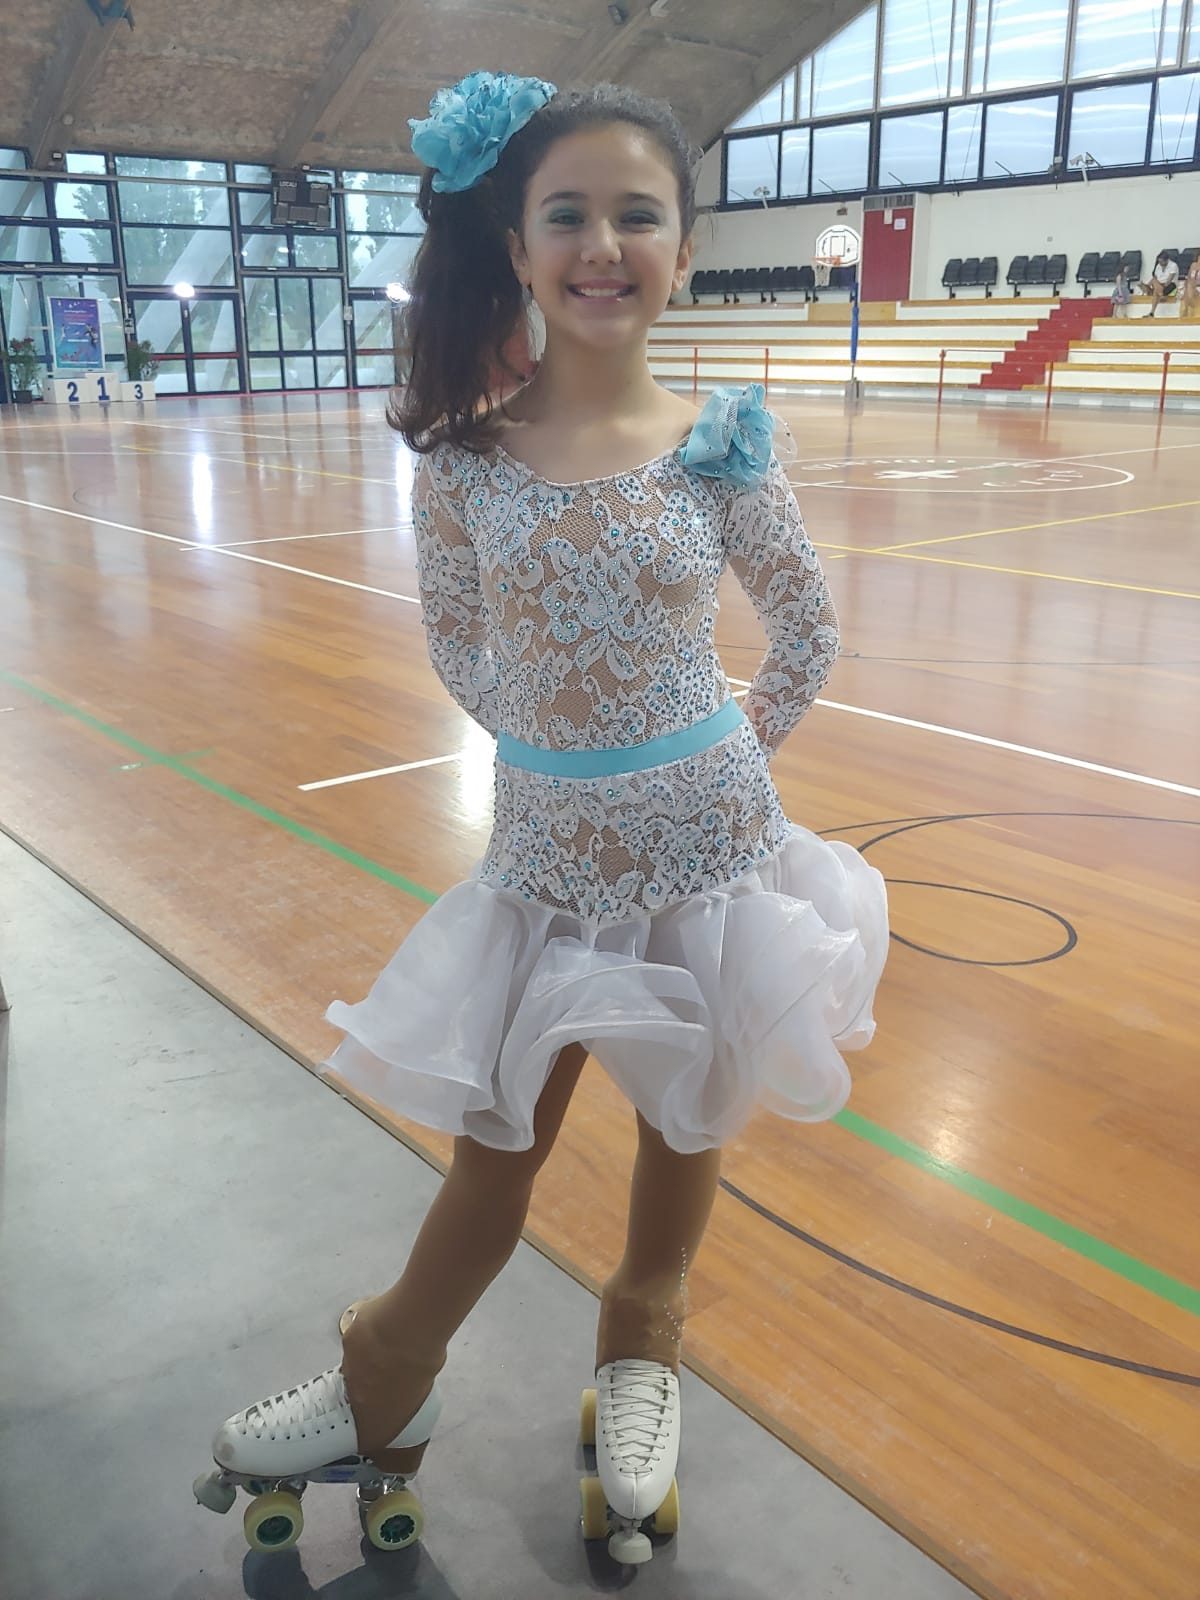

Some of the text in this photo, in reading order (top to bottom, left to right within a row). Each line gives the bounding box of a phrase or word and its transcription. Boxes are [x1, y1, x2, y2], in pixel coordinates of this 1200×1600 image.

[67, 382, 79, 402] 2
[97, 377, 110, 400] 1
[134, 384, 143, 399] 3
